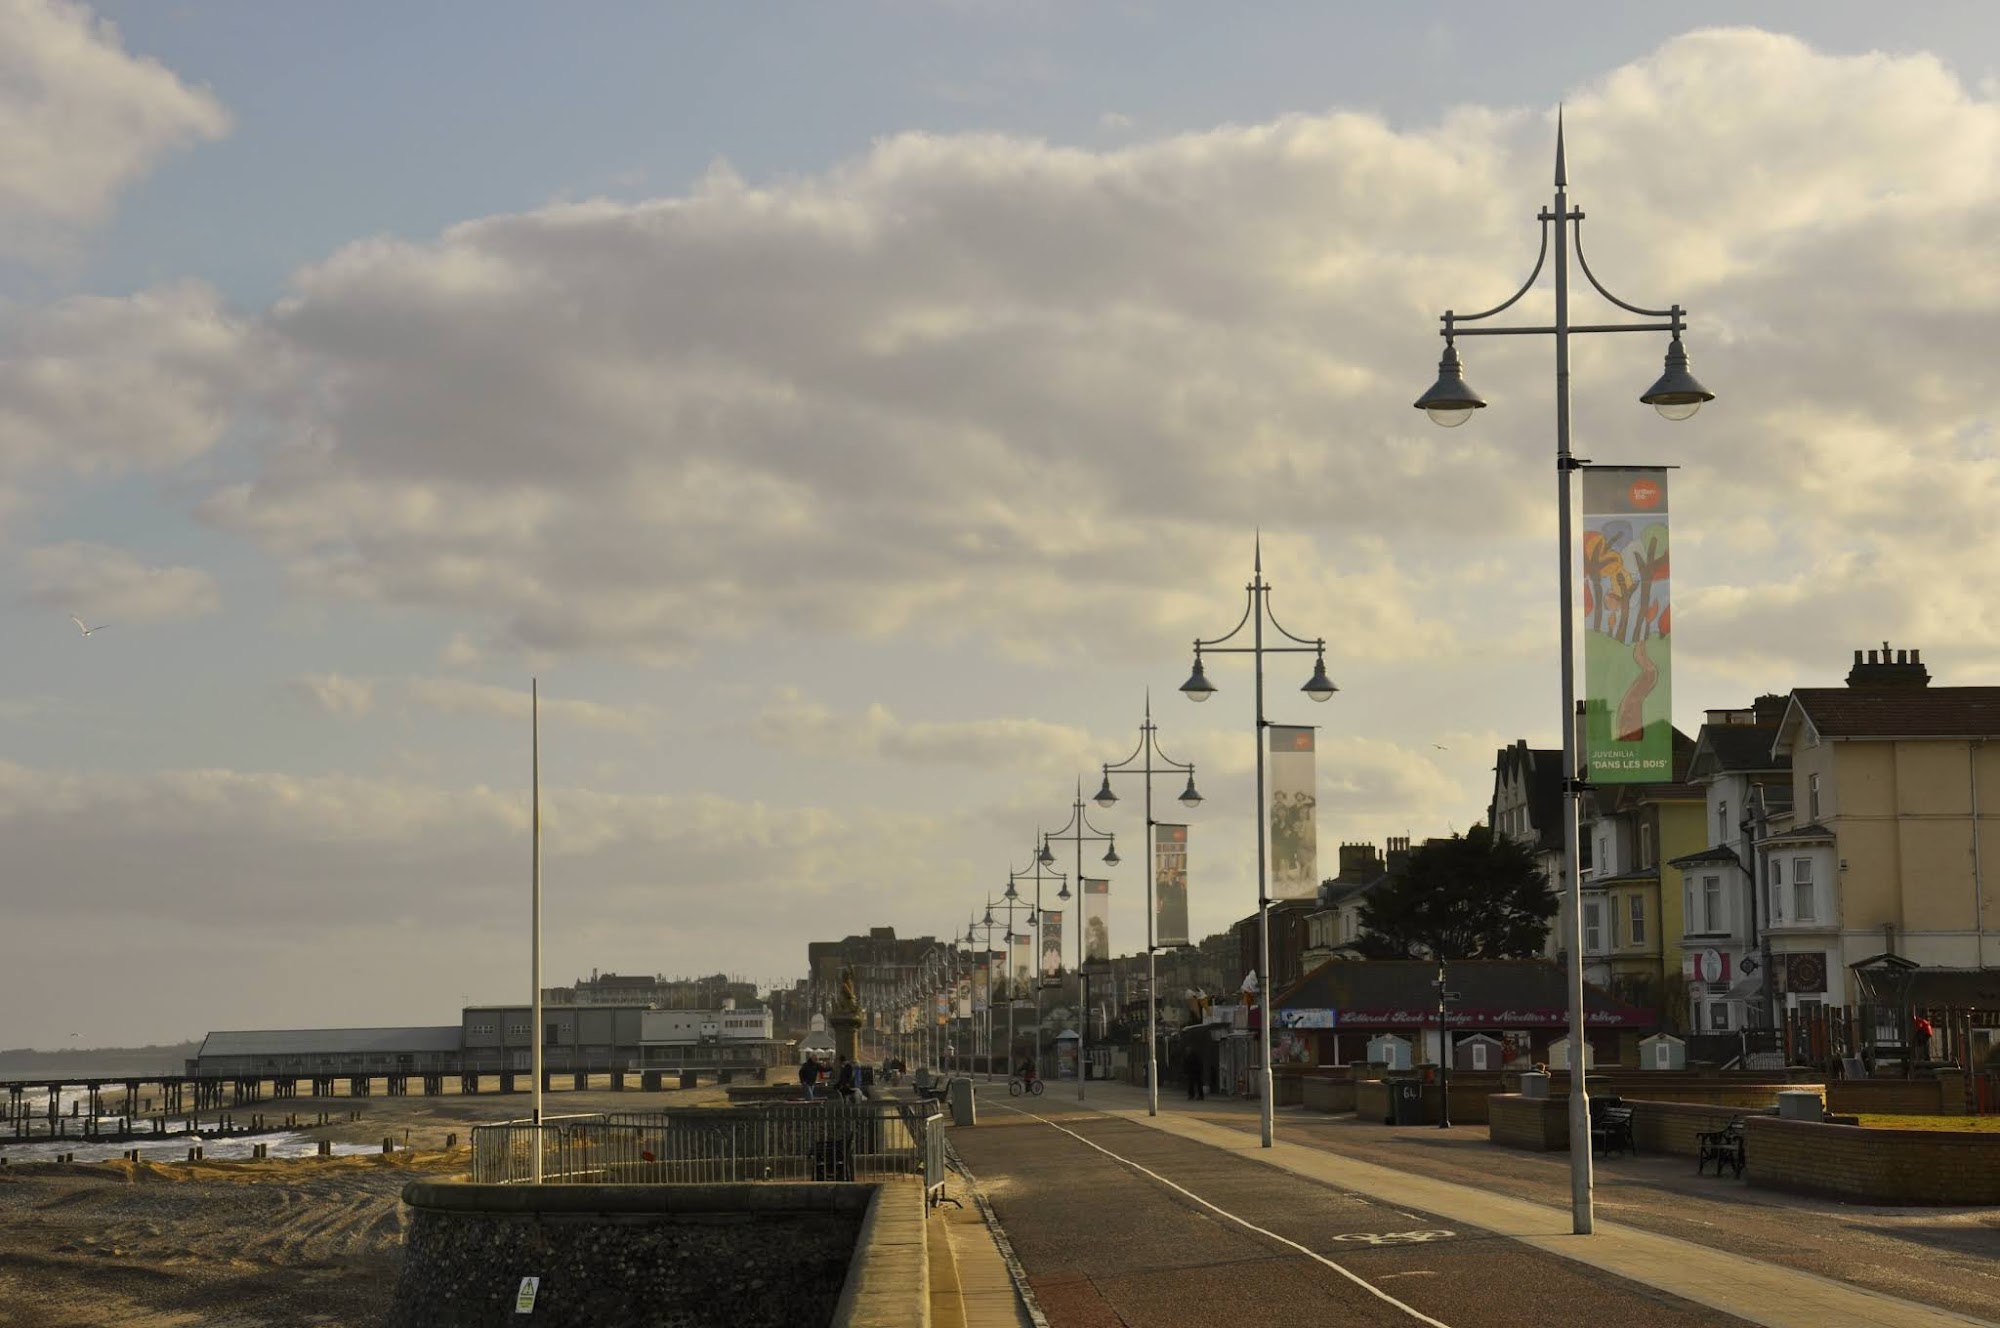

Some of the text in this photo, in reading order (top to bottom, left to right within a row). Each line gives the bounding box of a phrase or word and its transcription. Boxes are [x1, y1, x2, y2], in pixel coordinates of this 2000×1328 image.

[1592, 750, 1634, 758] JUVENILIA
[1622, 760, 1641, 769] LES
[1391, 1011, 1424, 1022] Rock
[1590, 1010, 1622, 1023] Shop
